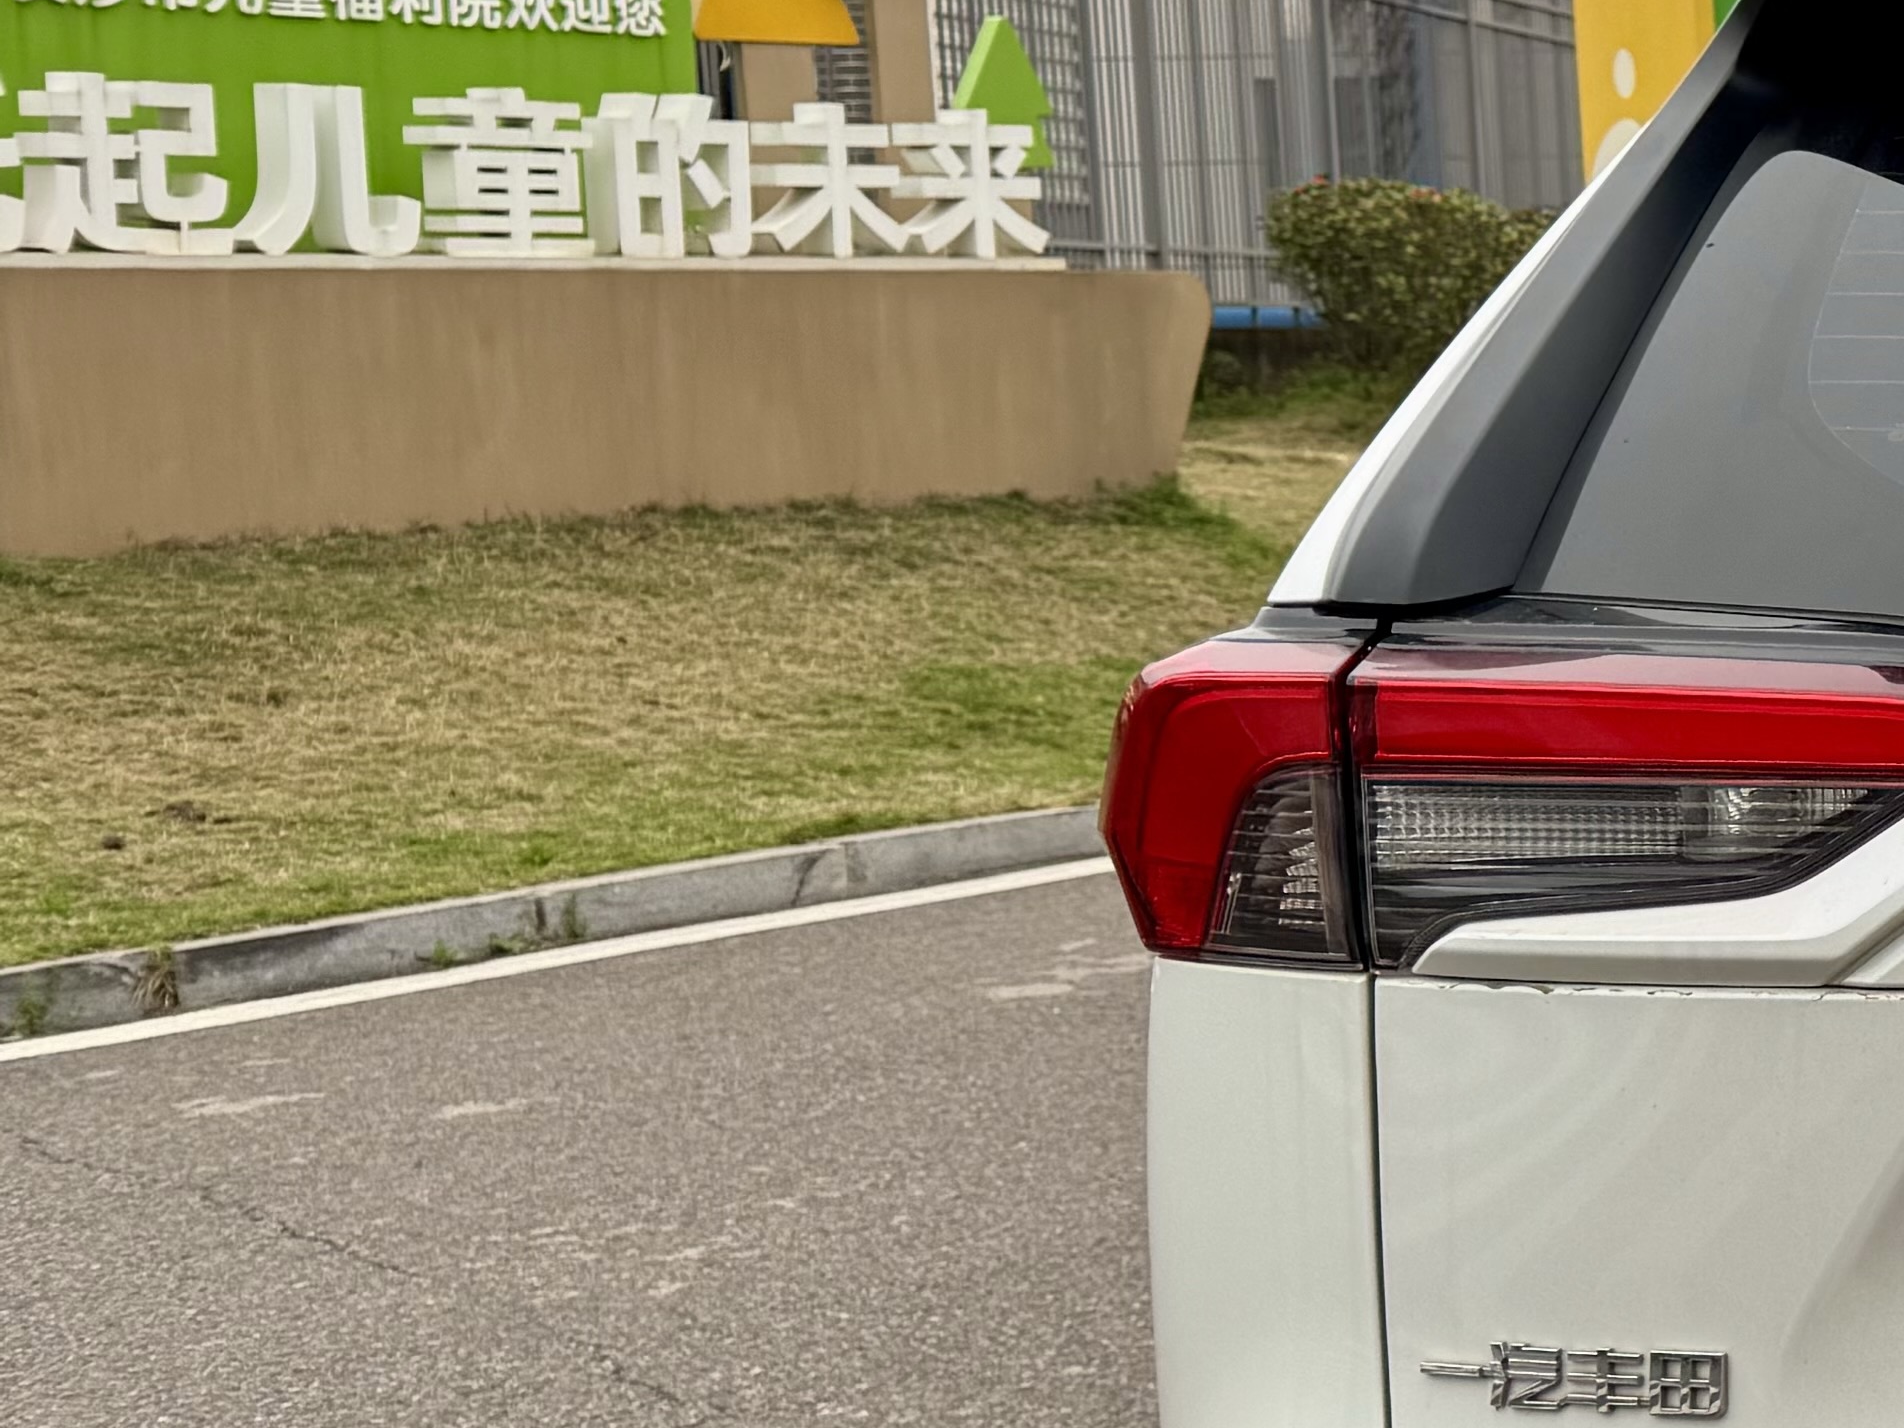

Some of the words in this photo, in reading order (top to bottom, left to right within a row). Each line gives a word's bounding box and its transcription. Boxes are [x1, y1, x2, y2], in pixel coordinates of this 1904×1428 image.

[0, 70, 1052, 260] 起儿童的未来
